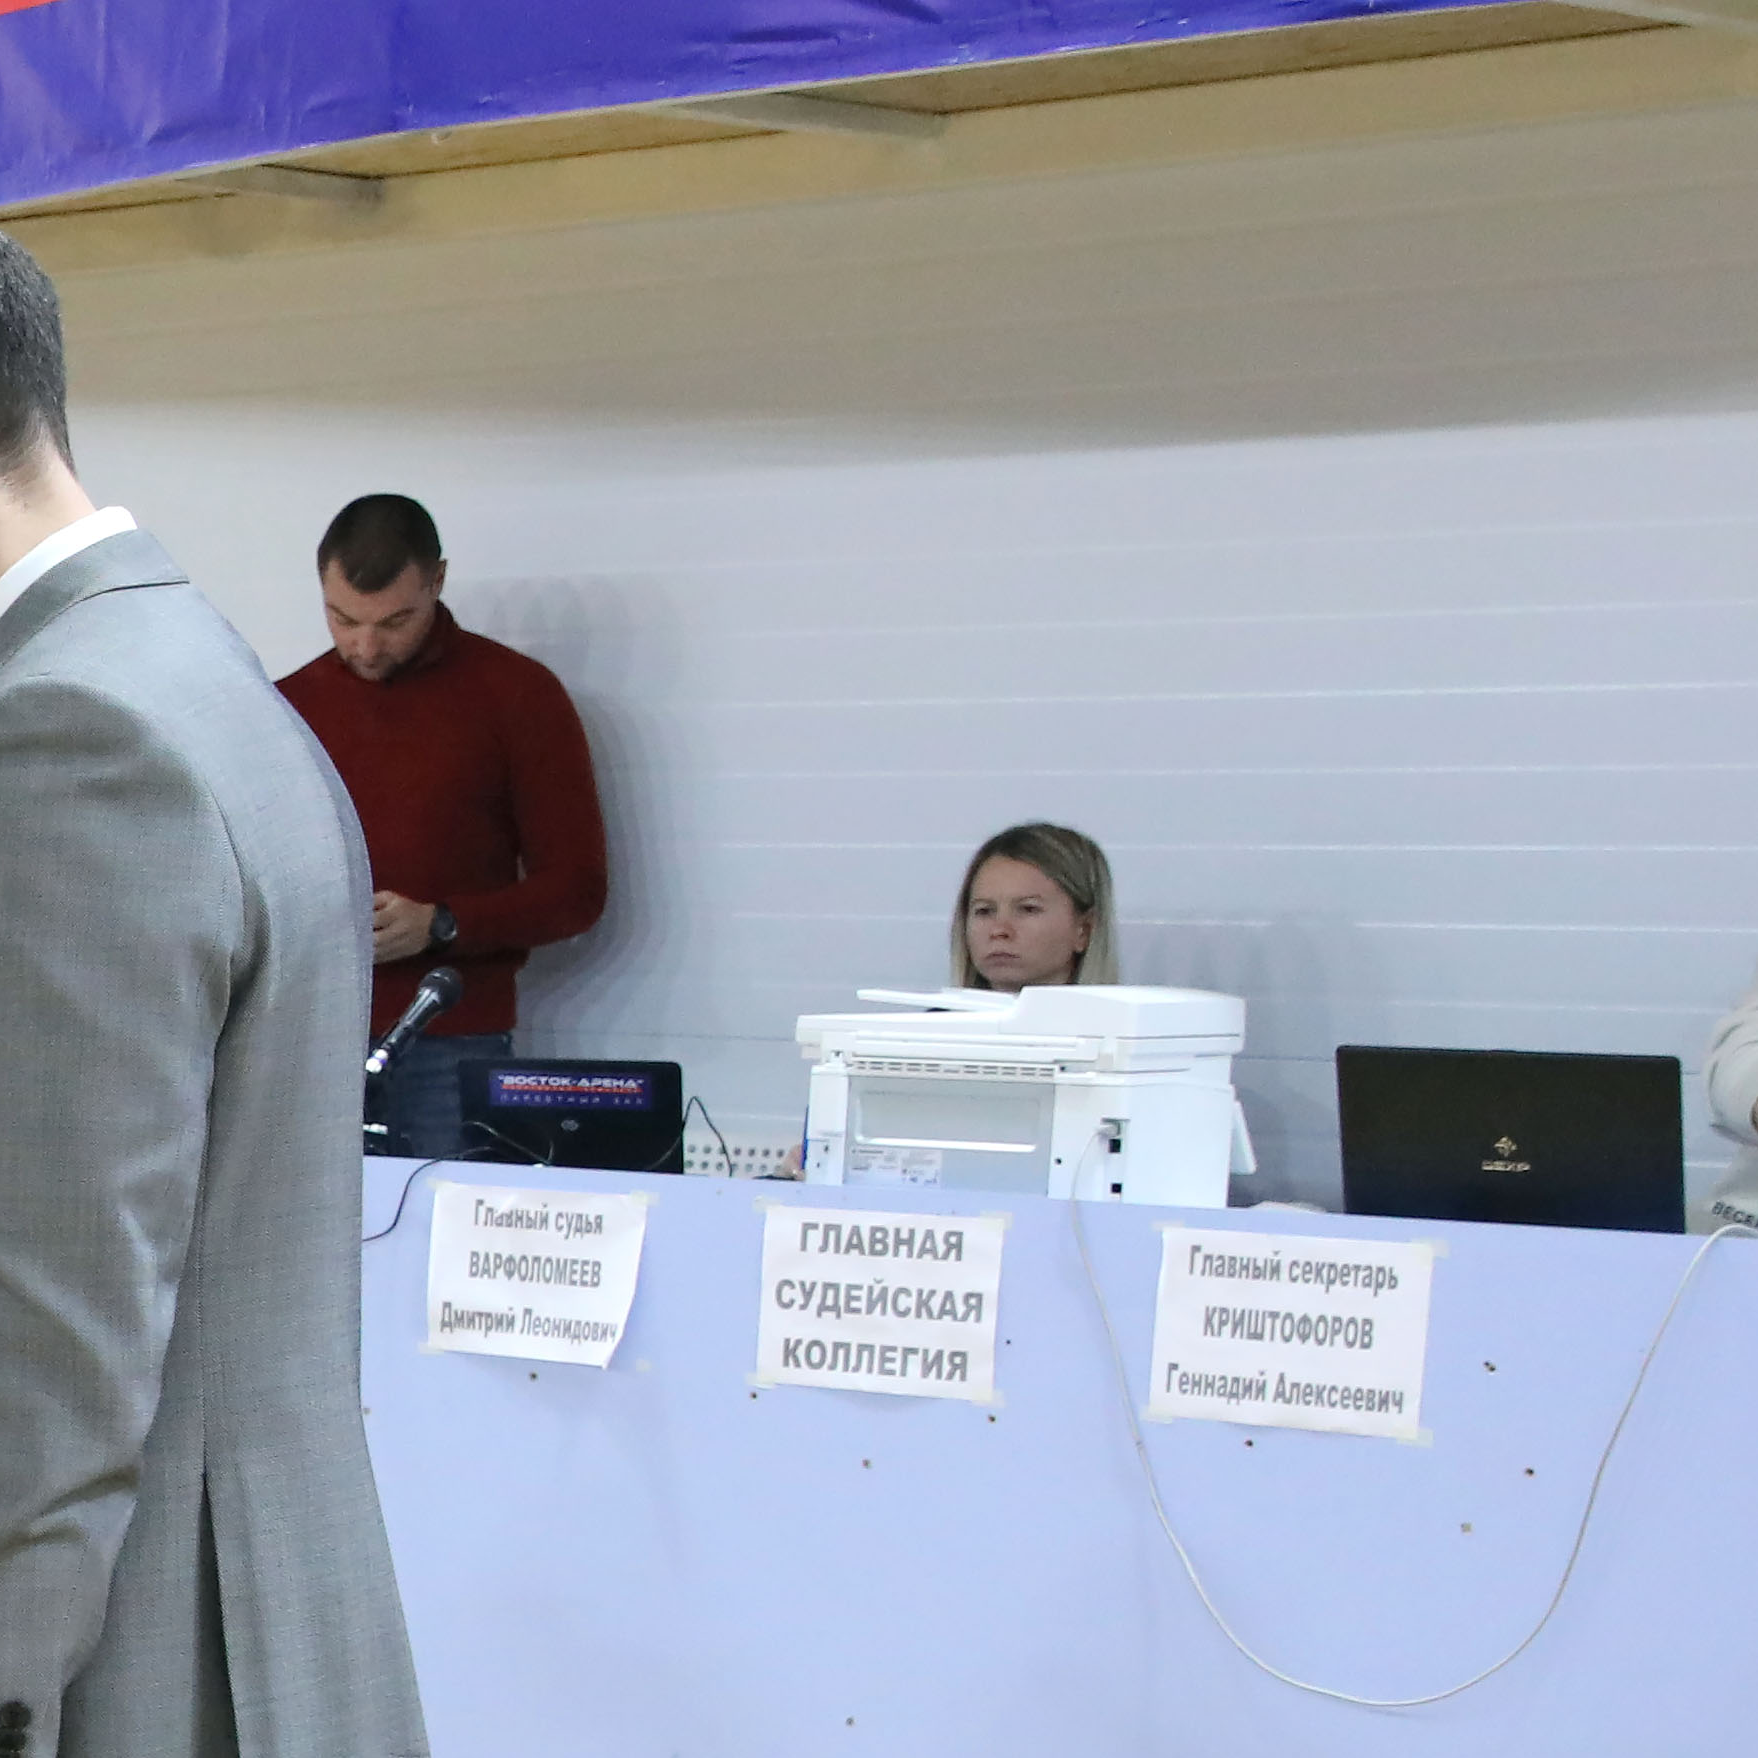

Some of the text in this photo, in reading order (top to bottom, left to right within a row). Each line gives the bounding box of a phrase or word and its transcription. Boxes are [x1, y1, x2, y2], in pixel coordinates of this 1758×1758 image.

[474, 1199, 604, 1240] Главный судья
[799, 1221, 964, 1262] ГЛАВНАЯ
[468, 1250, 602, 1288] ВАРФОЛОМЕЕВ
[1189, 1244, 1399, 1297] Главный секретарь
[775, 1277, 984, 1323] СУДЕЙСКАЯ
[440, 1301, 618, 1345] Дмитрий Леонидович
[1203, 1305, 1374, 1350] КРИШТОФОРОВ
[782, 1337, 969, 1382] КОЛЛЕГИЯ
[1165, 1362, 1405, 1415] Геннадий Алексеевич
